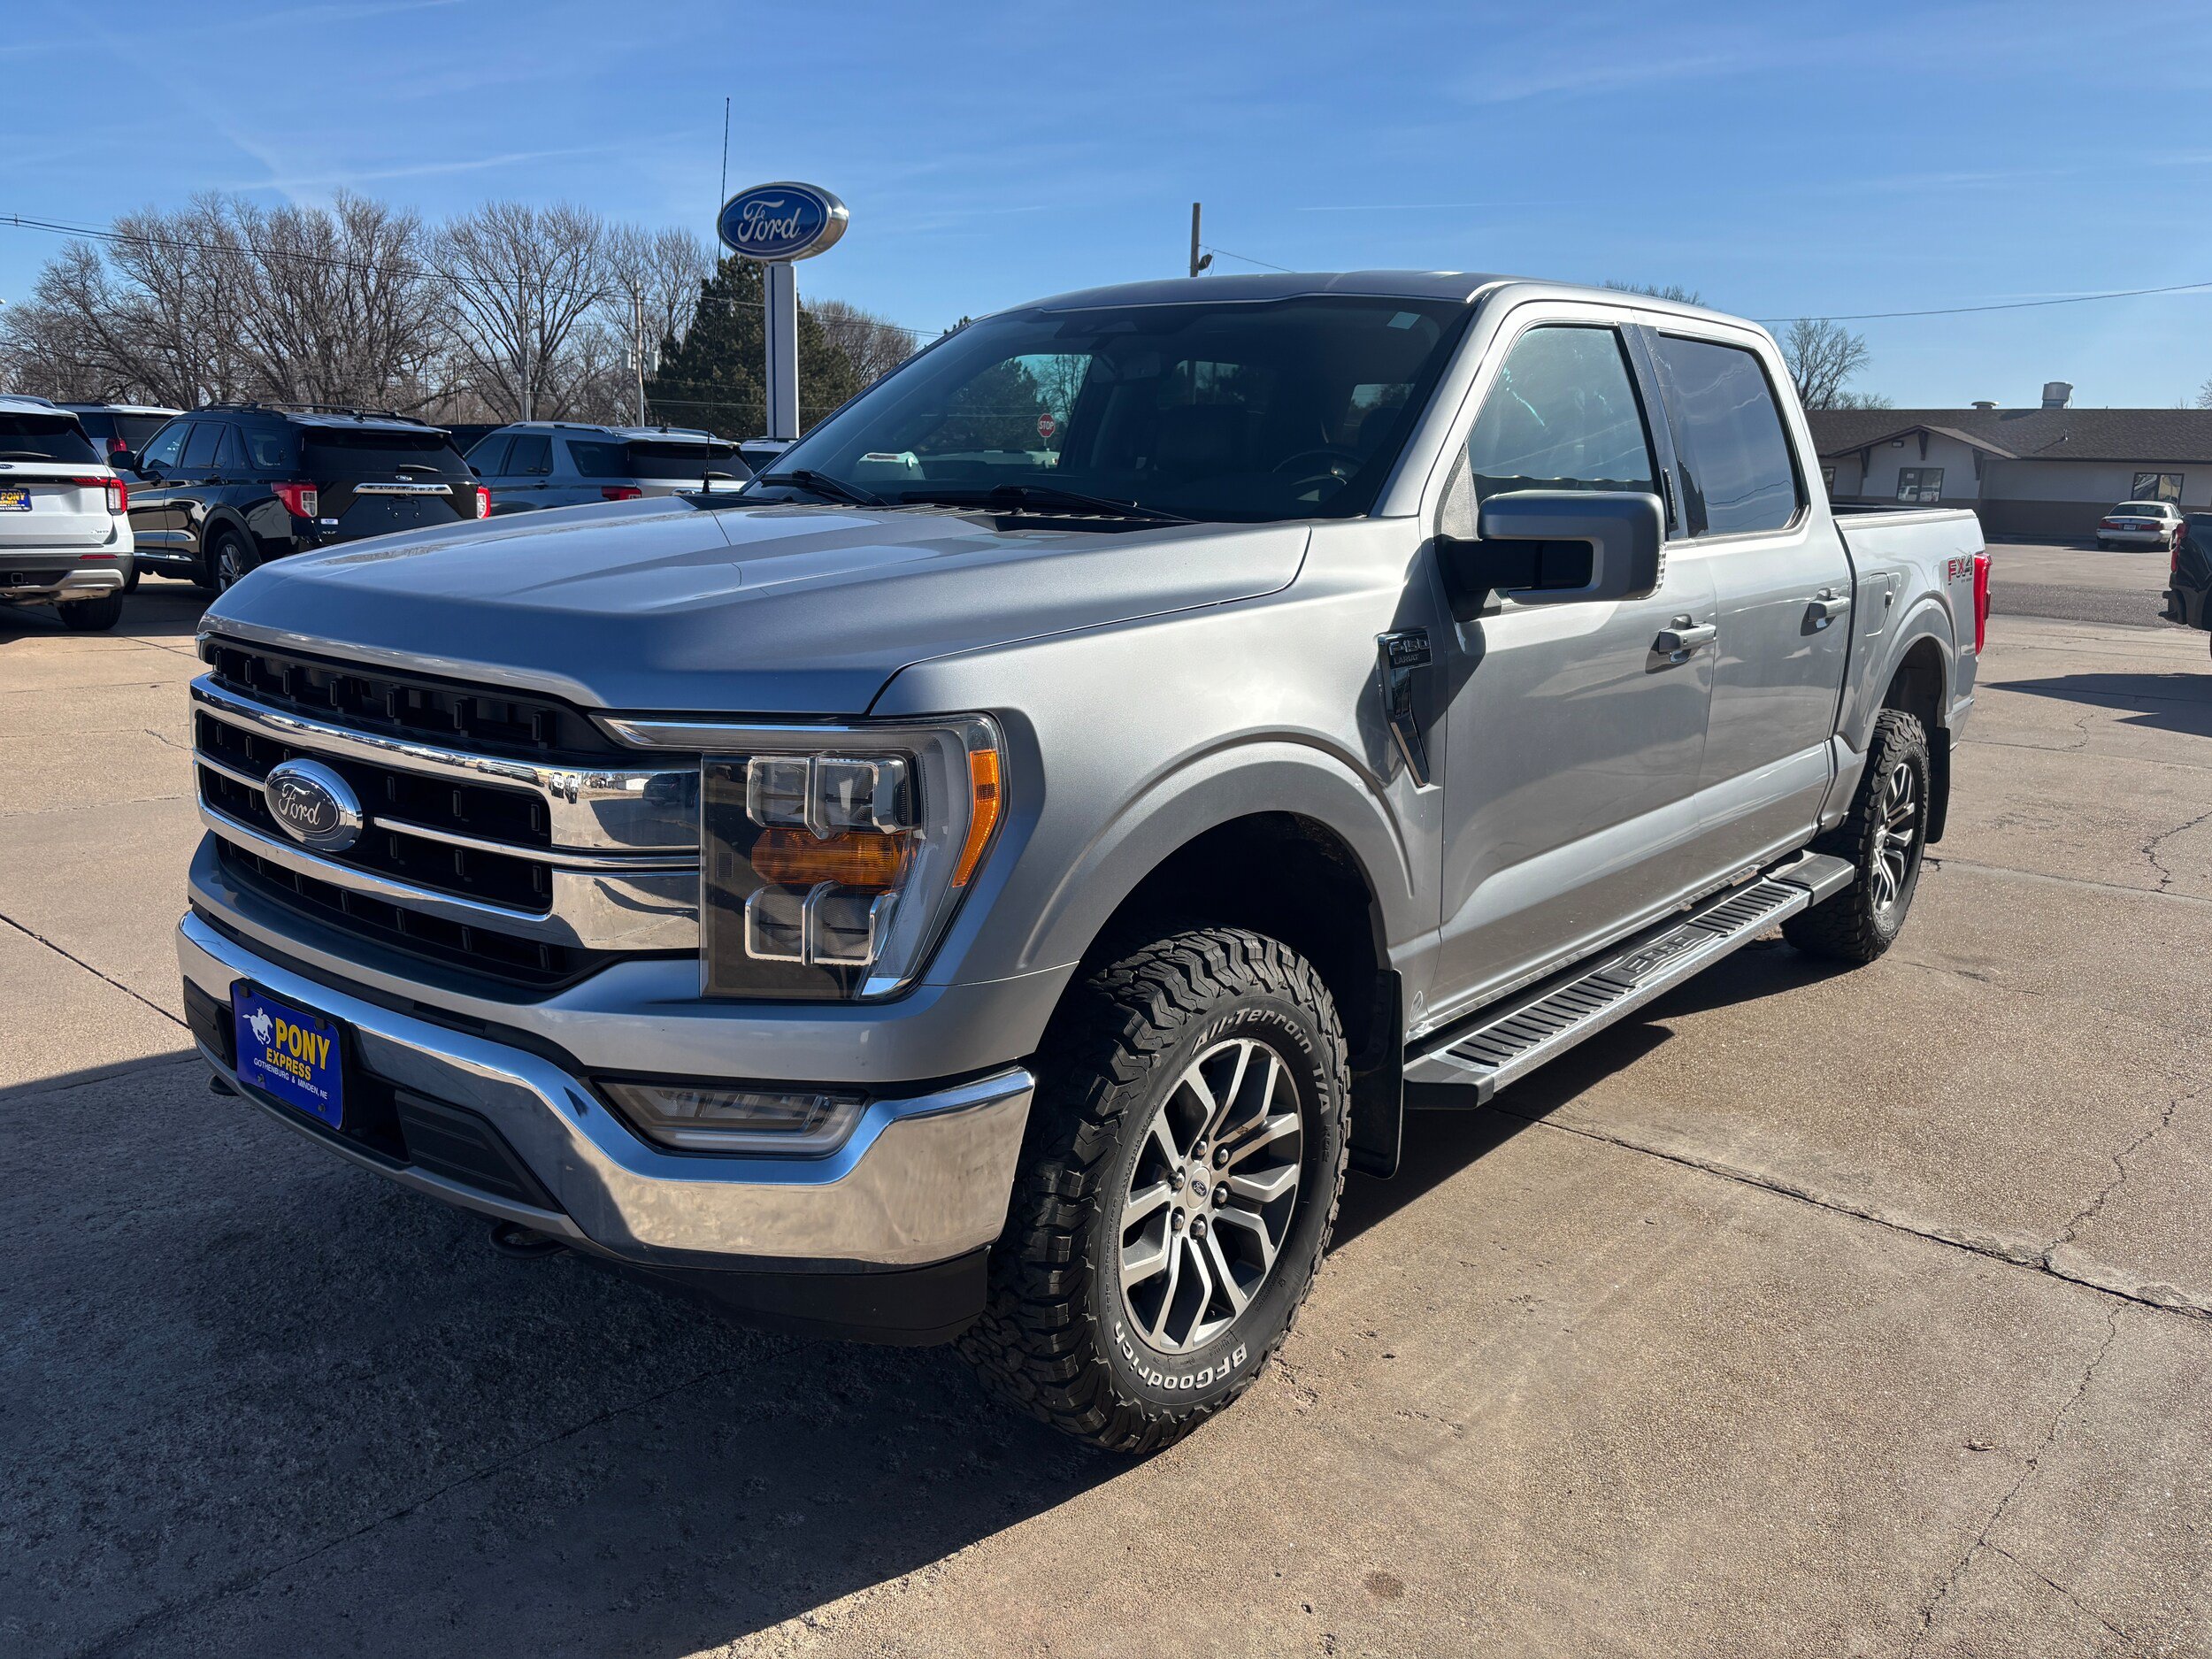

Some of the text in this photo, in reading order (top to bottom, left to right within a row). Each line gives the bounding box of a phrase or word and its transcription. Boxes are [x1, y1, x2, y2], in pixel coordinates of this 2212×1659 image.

[737, 199, 803, 243] Ford
[1039, 420, 1054, 430] STOP
[1, 492, 26, 501] PONY
[1947, 555, 1973, 586] FX4
[1389, 638, 1430, 656] F-150
[1394, 655, 1419, 664] LARIAT
[278, 782, 321, 826] Ford
[275, 1018, 331, 1071] PONY
[1191, 1007, 1331, 1115] All-Terrain T/A
[253, 1057, 328, 1100] GOTHENBURG & MINDEN, NE
[266, 1048, 311, 1081] EXPRESS
[1114, 1320, 1248, 1392] BFGoodrich
